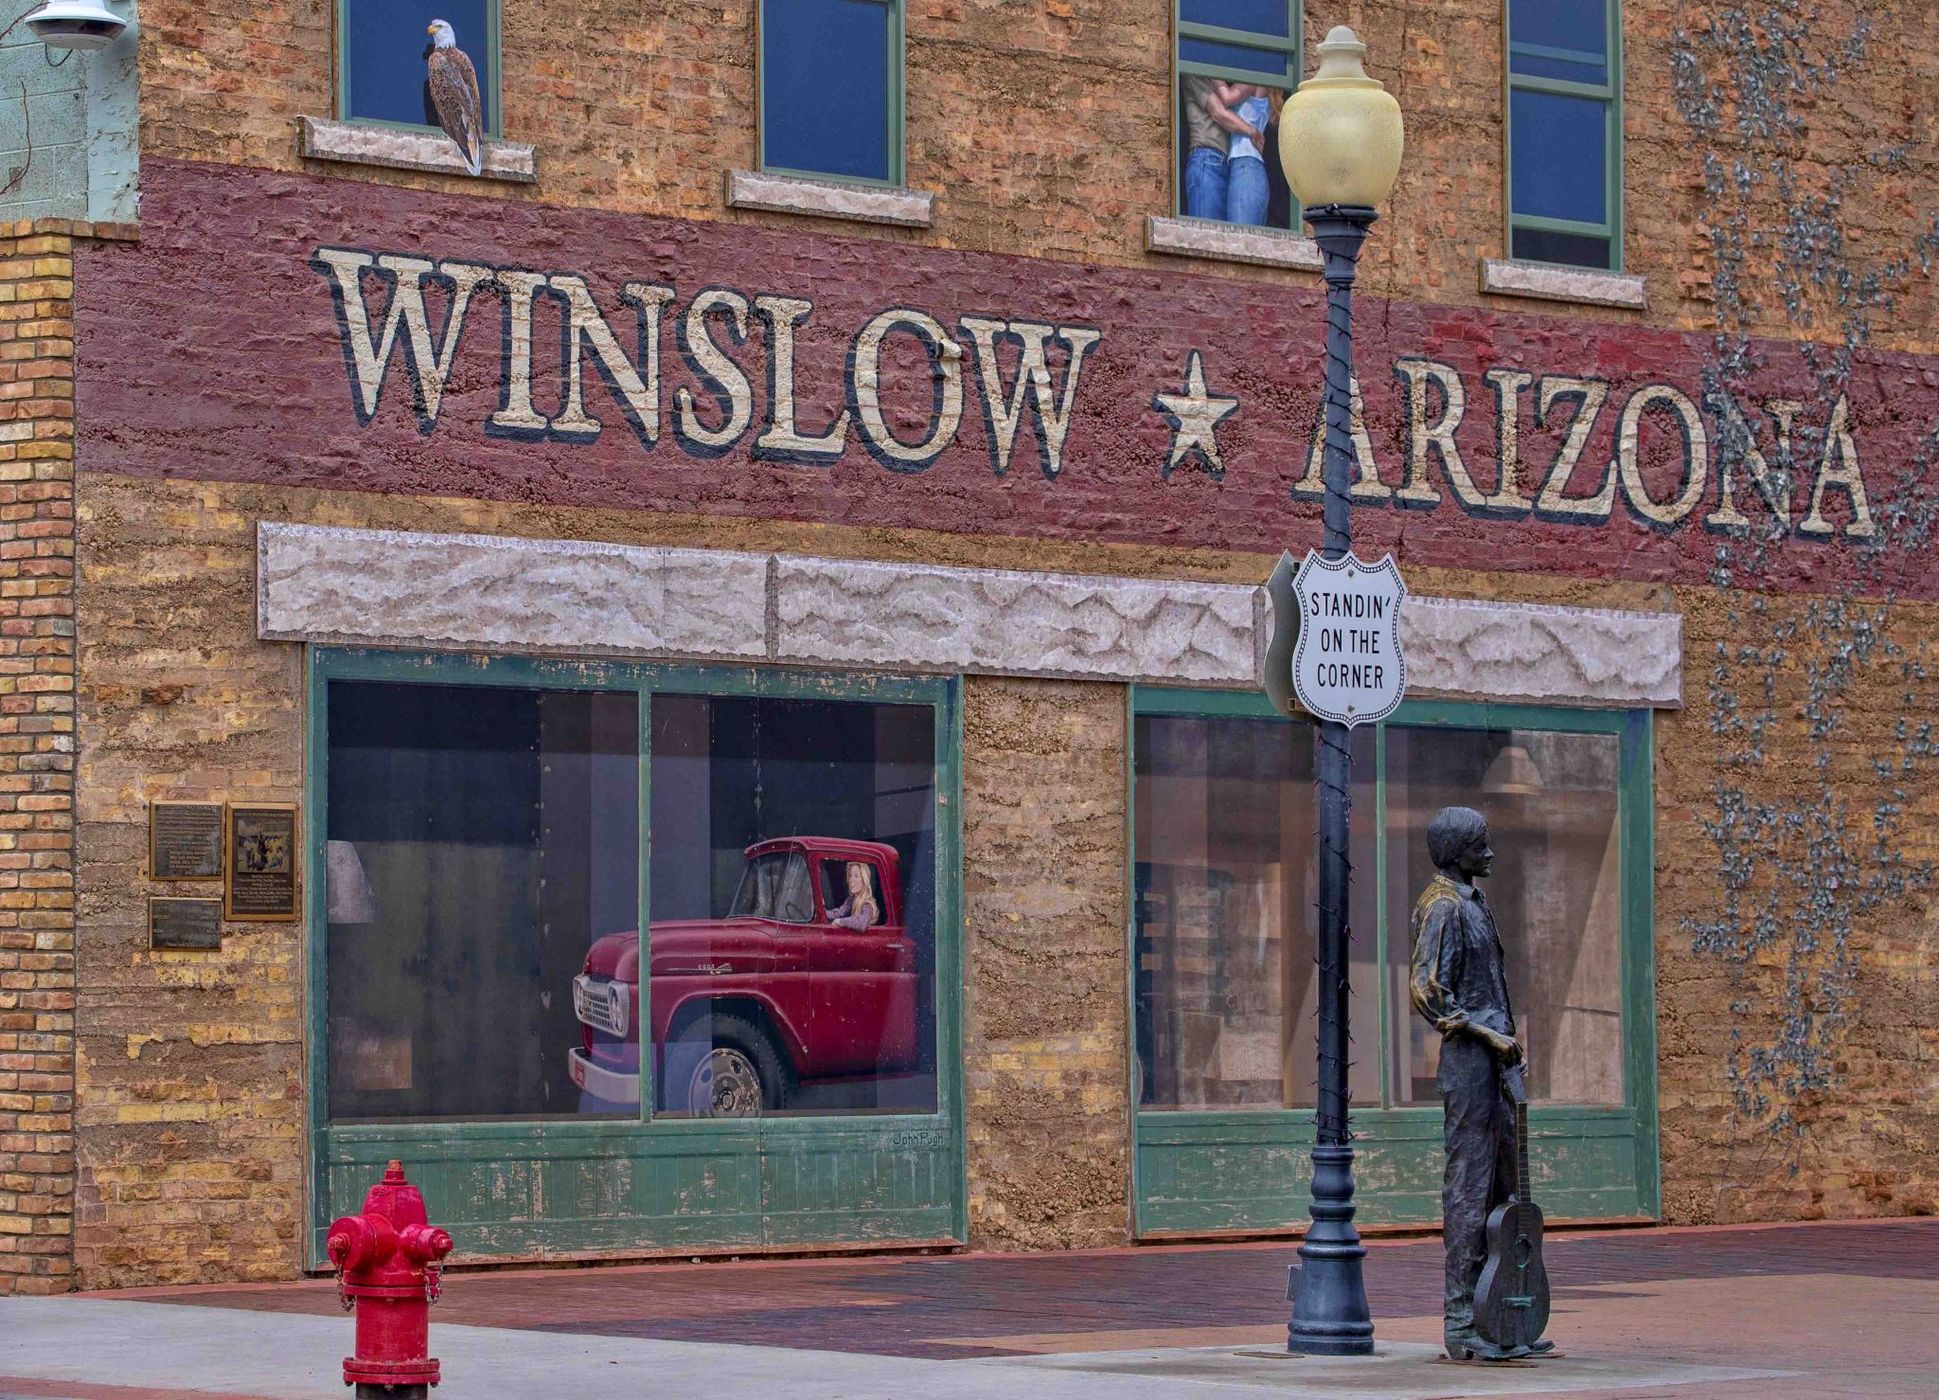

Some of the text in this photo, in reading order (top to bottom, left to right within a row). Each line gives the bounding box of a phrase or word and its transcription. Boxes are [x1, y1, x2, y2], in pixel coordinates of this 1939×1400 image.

[311, 245, 1877, 544] WINSLOW ARIZONA
[1311, 592, 1391, 619] STANDIN'
[1321, 628, 1380, 654] ON THE
[1317, 663, 1383, 689] CORNER
[893, 1130, 944, 1147] John Pugh
